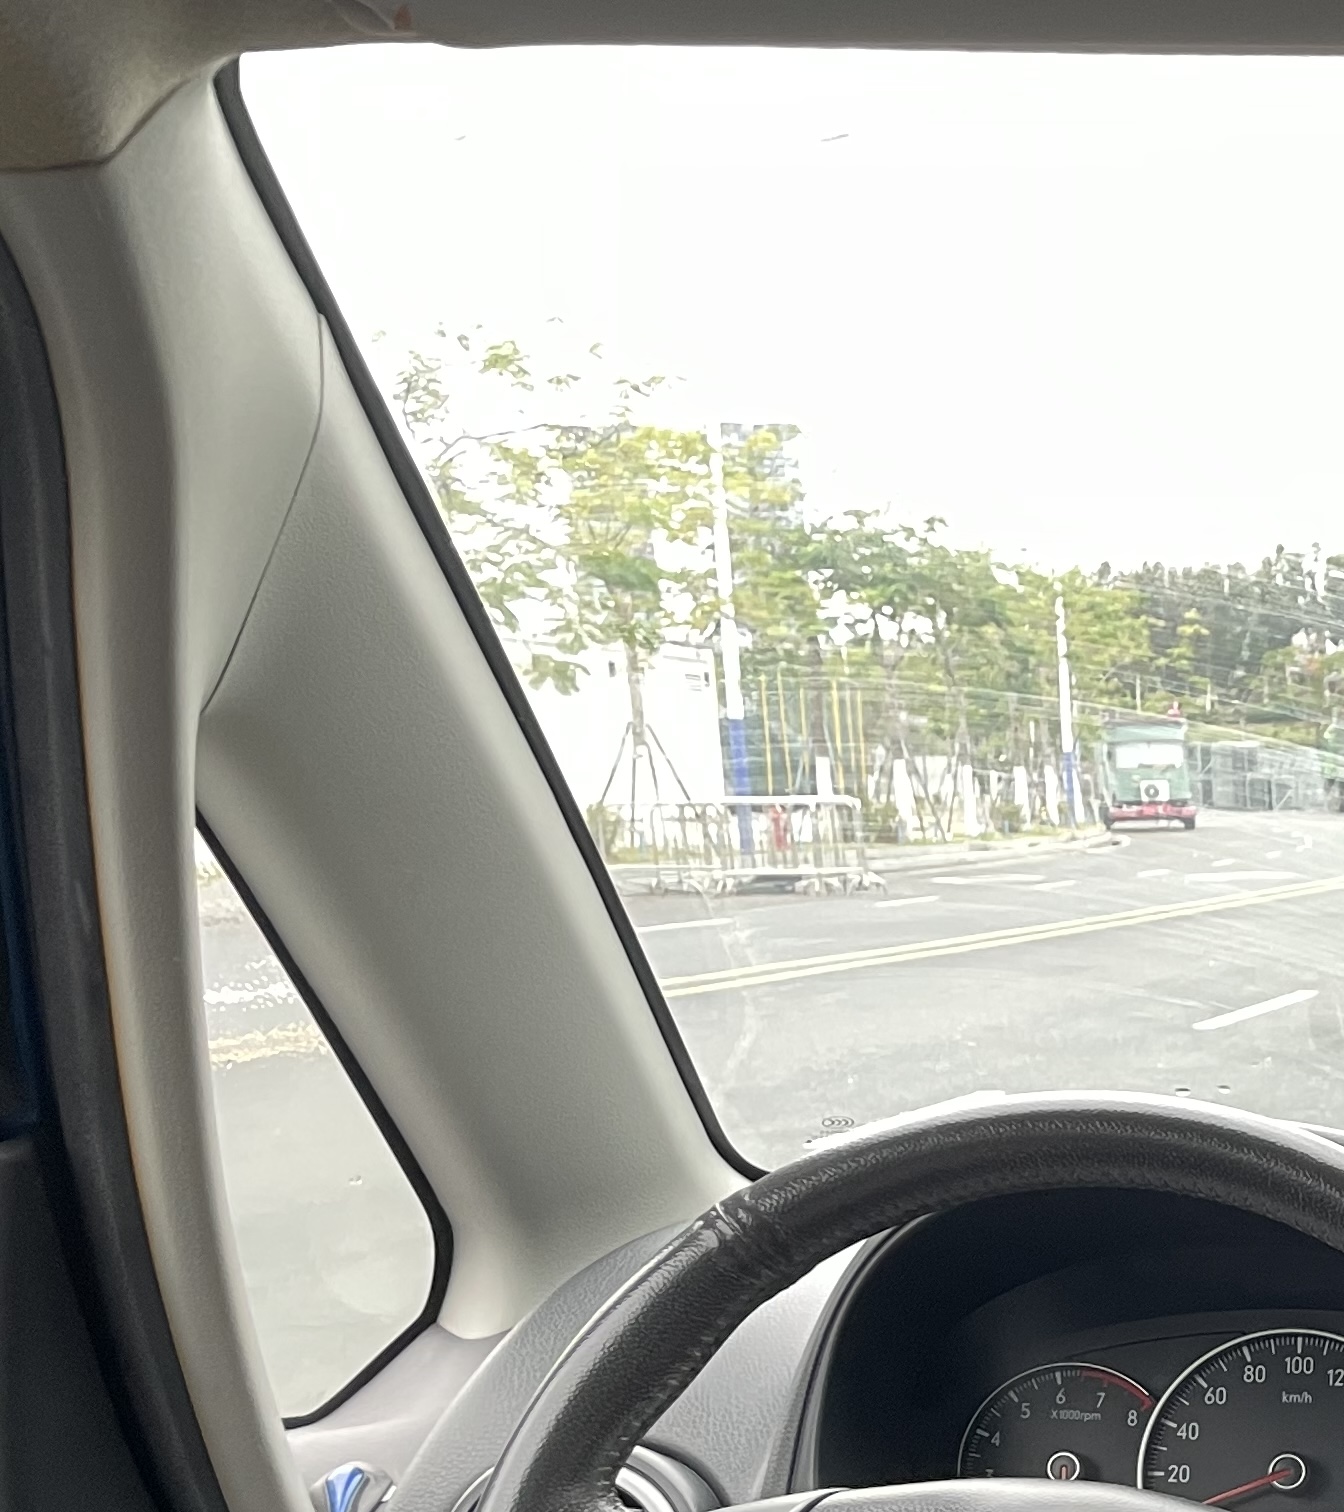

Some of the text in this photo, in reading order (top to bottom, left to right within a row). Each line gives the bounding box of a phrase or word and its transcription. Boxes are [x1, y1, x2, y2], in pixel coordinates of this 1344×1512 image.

[1243, 1365, 1266, 1383] 80
[1284, 1356, 1314, 1375] 100
[1056, 1388, 1066, 1404] 6
[1096, 1392, 1105, 1408] 7
[1204, 1387, 1227, 1405] 60
[1281, 1391, 1313, 1404] km/h
[1020, 1403, 1031, 1419] 5
[1127, 1410, 1138, 1427] 8
[990, 1431, 1000, 1447] 4
[1176, 1422, 1199, 1440] 40
[1167, 1465, 1190, 1483] 20
